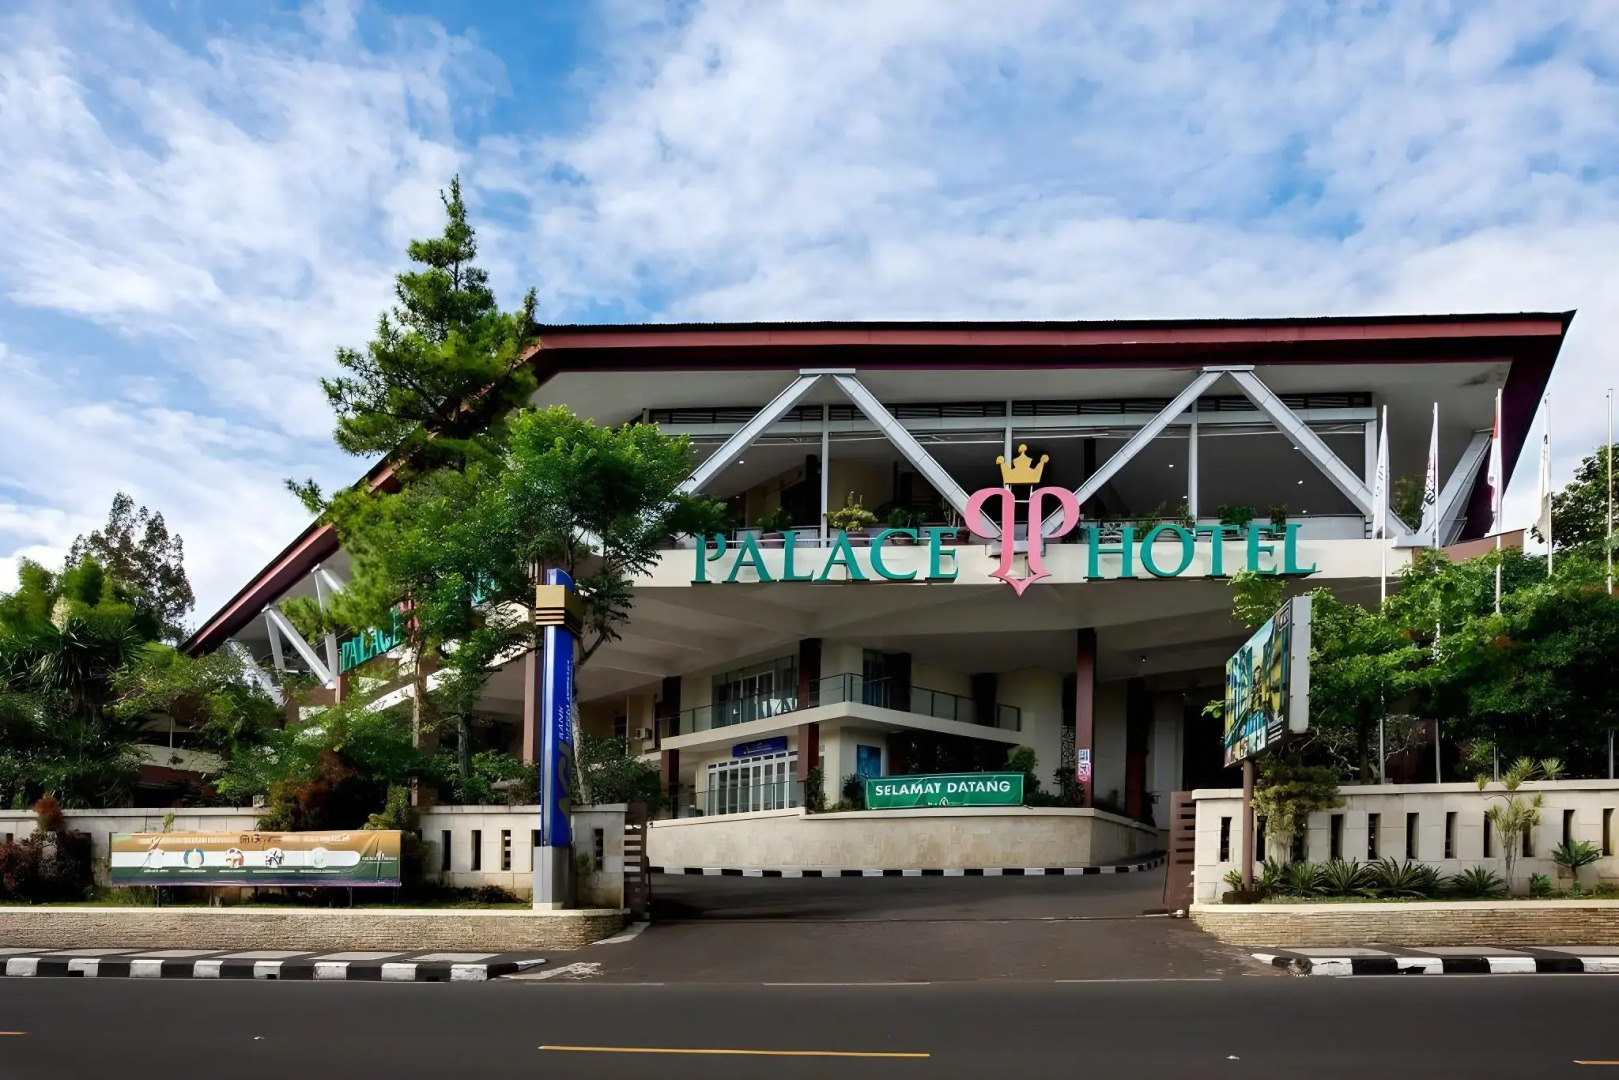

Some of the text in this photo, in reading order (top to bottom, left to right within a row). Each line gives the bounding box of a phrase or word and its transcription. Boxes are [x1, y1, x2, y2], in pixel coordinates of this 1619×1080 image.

[692, 527, 959, 584] PALACE
[1086, 522, 1318, 581] HOTEL
[875, 780, 1011, 796] SELAMAT DATANG
